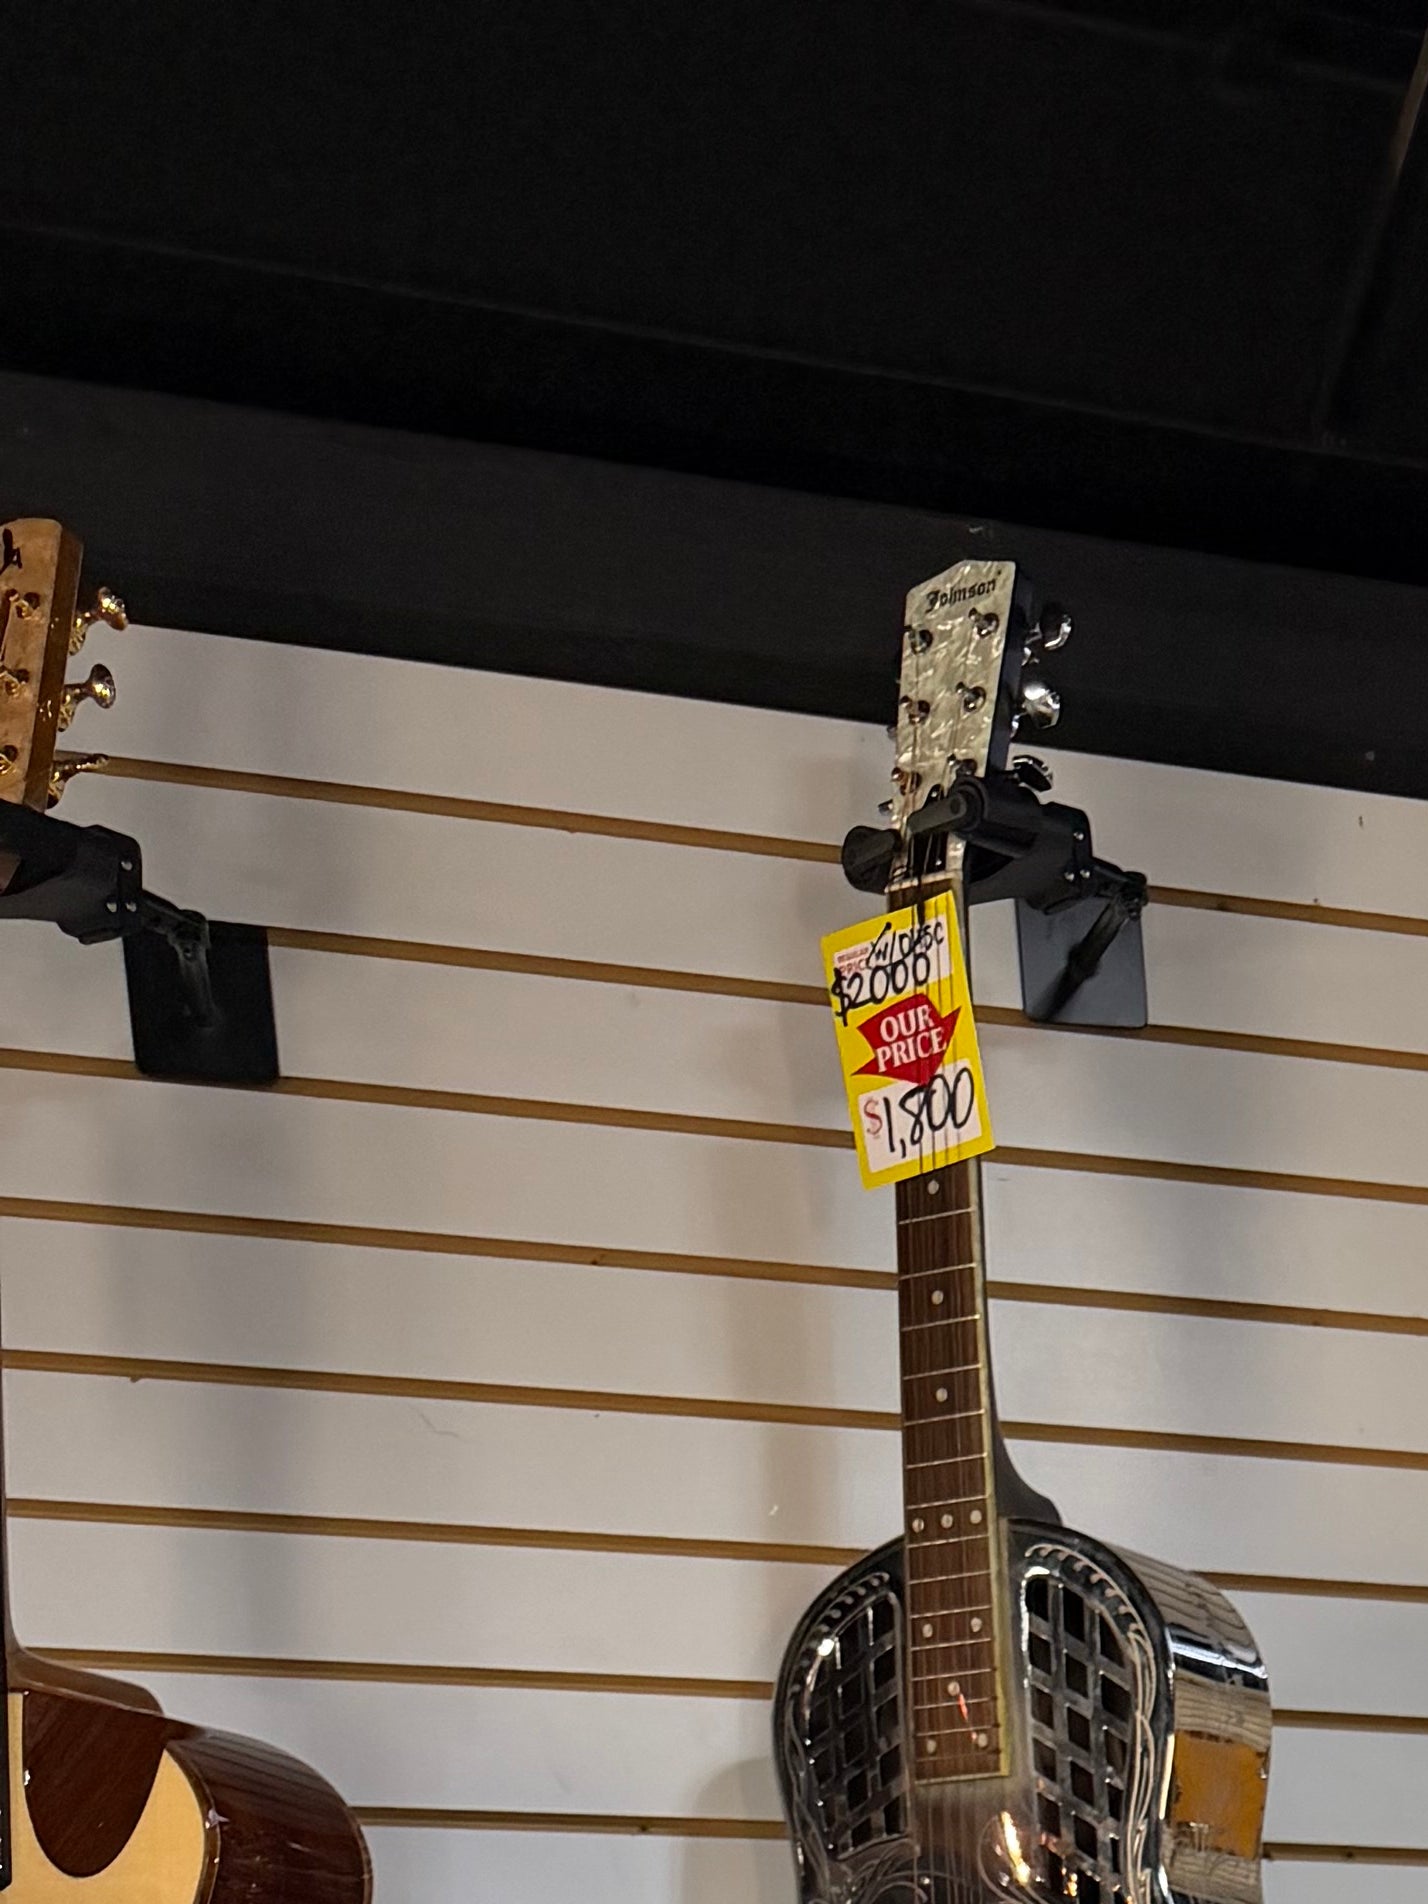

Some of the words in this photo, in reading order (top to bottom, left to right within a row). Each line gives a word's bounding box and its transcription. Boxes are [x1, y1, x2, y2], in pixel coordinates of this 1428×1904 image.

[925, 578, 997, 614] Johnson
[831, 952, 931, 1027] $2000
[880, 1004, 935, 1043] OUR
[876, 1026, 948, 1074] PRICE
